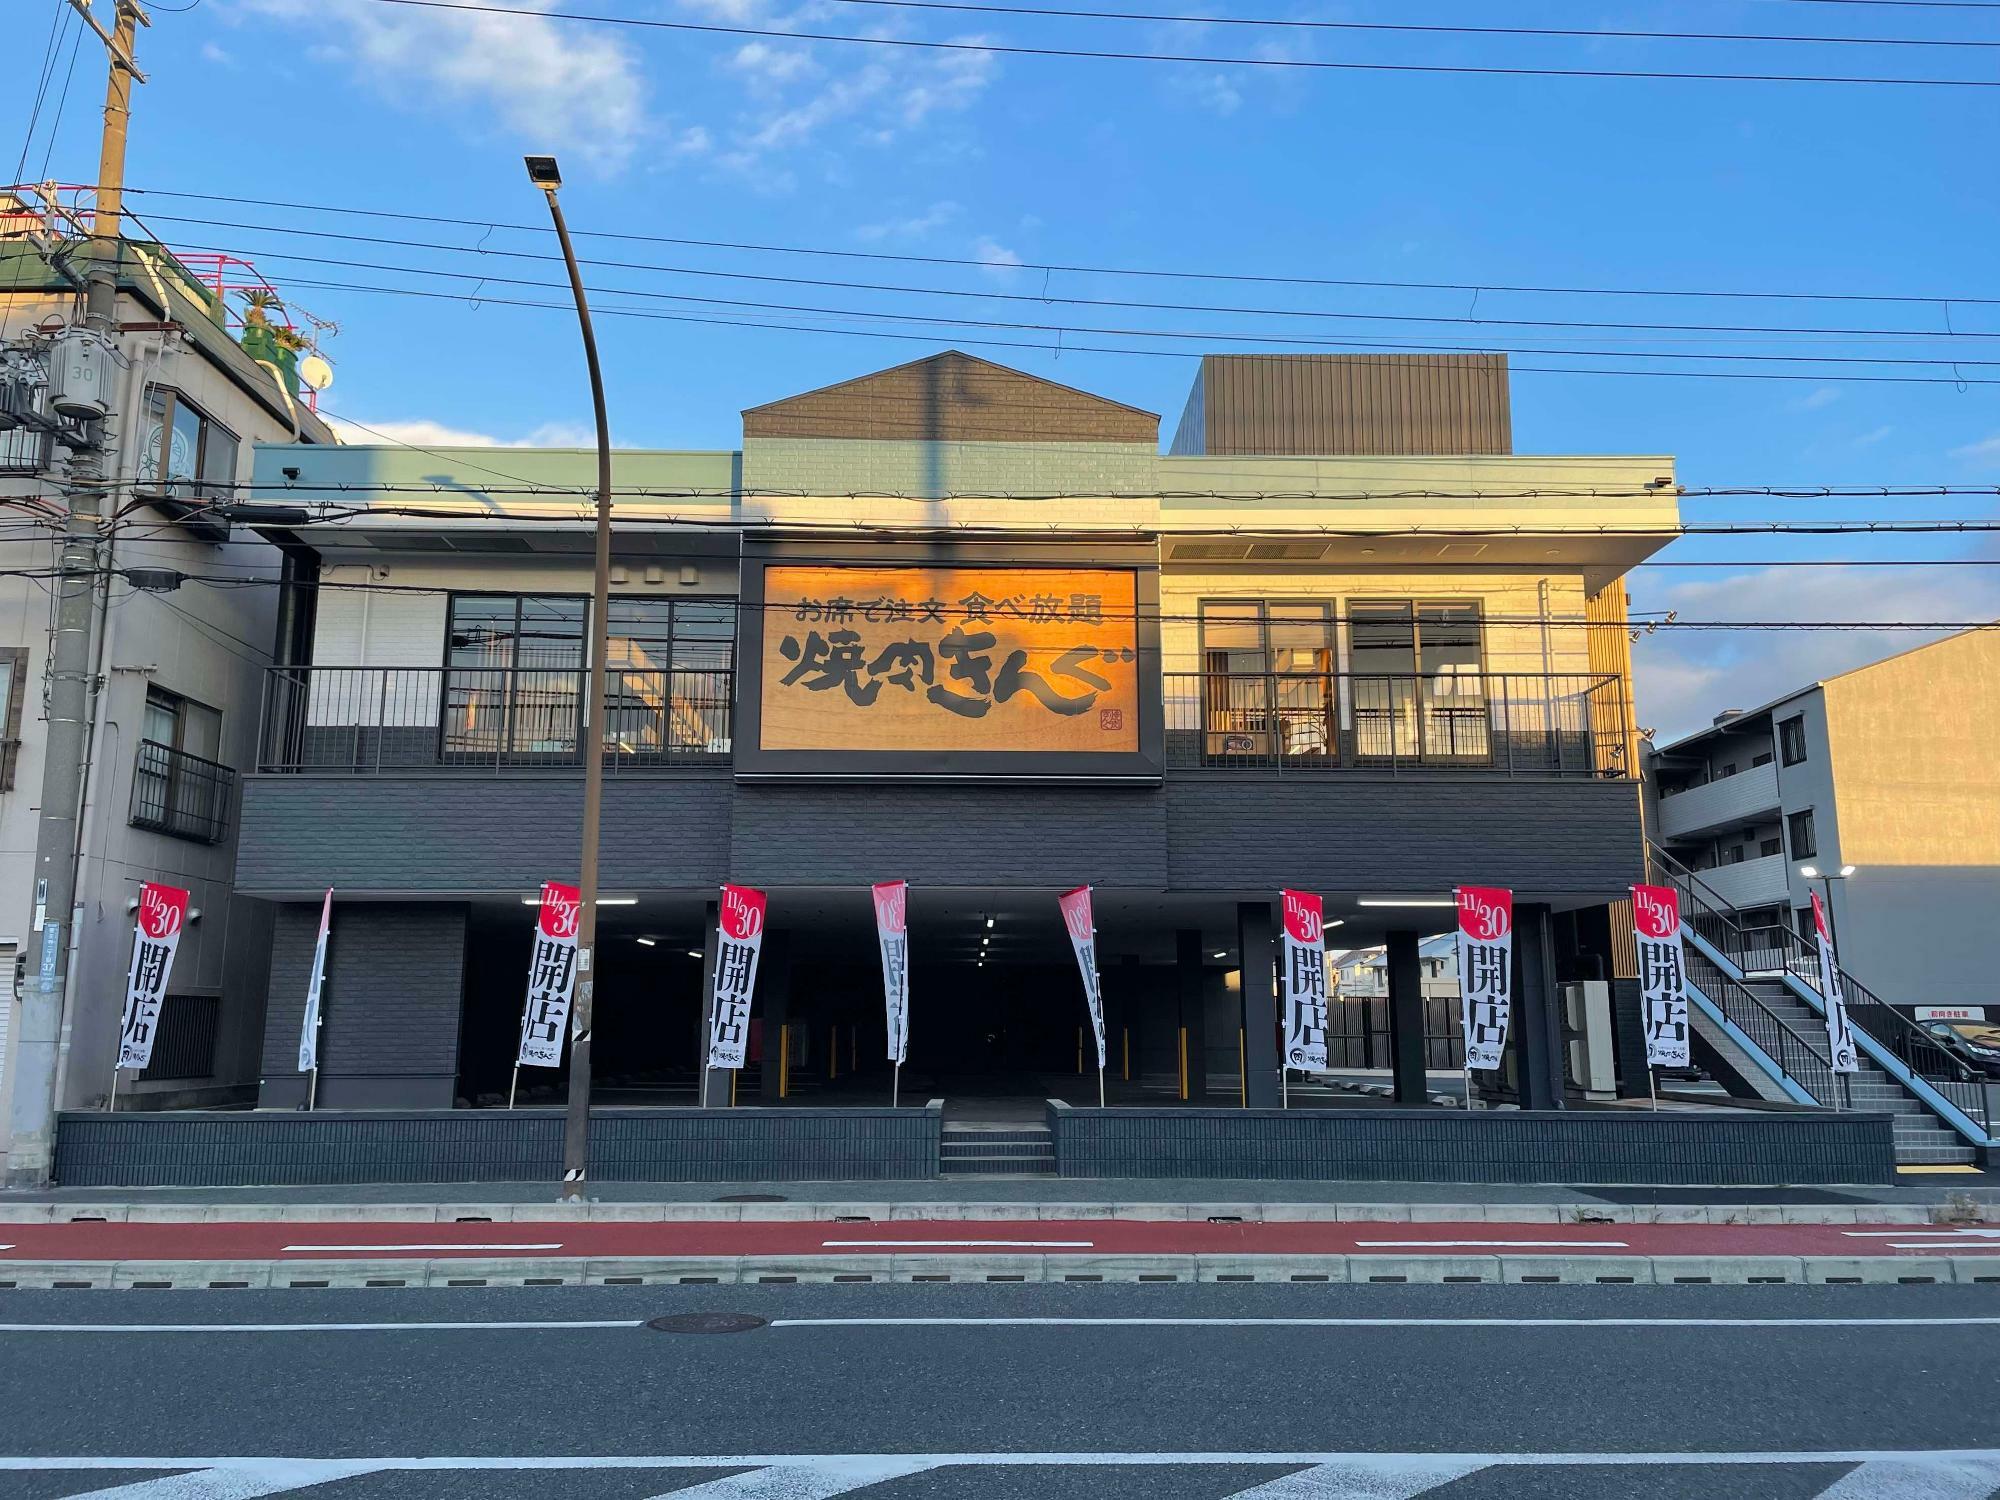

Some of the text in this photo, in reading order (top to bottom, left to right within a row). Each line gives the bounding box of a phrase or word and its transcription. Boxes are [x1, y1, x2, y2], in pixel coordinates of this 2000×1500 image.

[72, 366, 93, 382] 30
[795, 591, 1104, 626] お席で注文 食べ放題
[779, 627, 1136, 718] 焼肉きんぐ
[145, 889, 180, 936] 11/30
[726, 891, 761, 937] 11/30
[1286, 895, 1322, 941] 11/30
[1463, 893, 1507, 938] 11/30
[1636, 891, 1675, 935] 11/30
[123, 941, 171, 1044] 開店
[522, 939, 577, 1042] 開店
[712, 941, 756, 1044] 開店
[1290, 945, 1327, 1047] 開店
[1467, 944, 1509, 1045] 開店
[1641, 941, 1688, 1042] 開店
